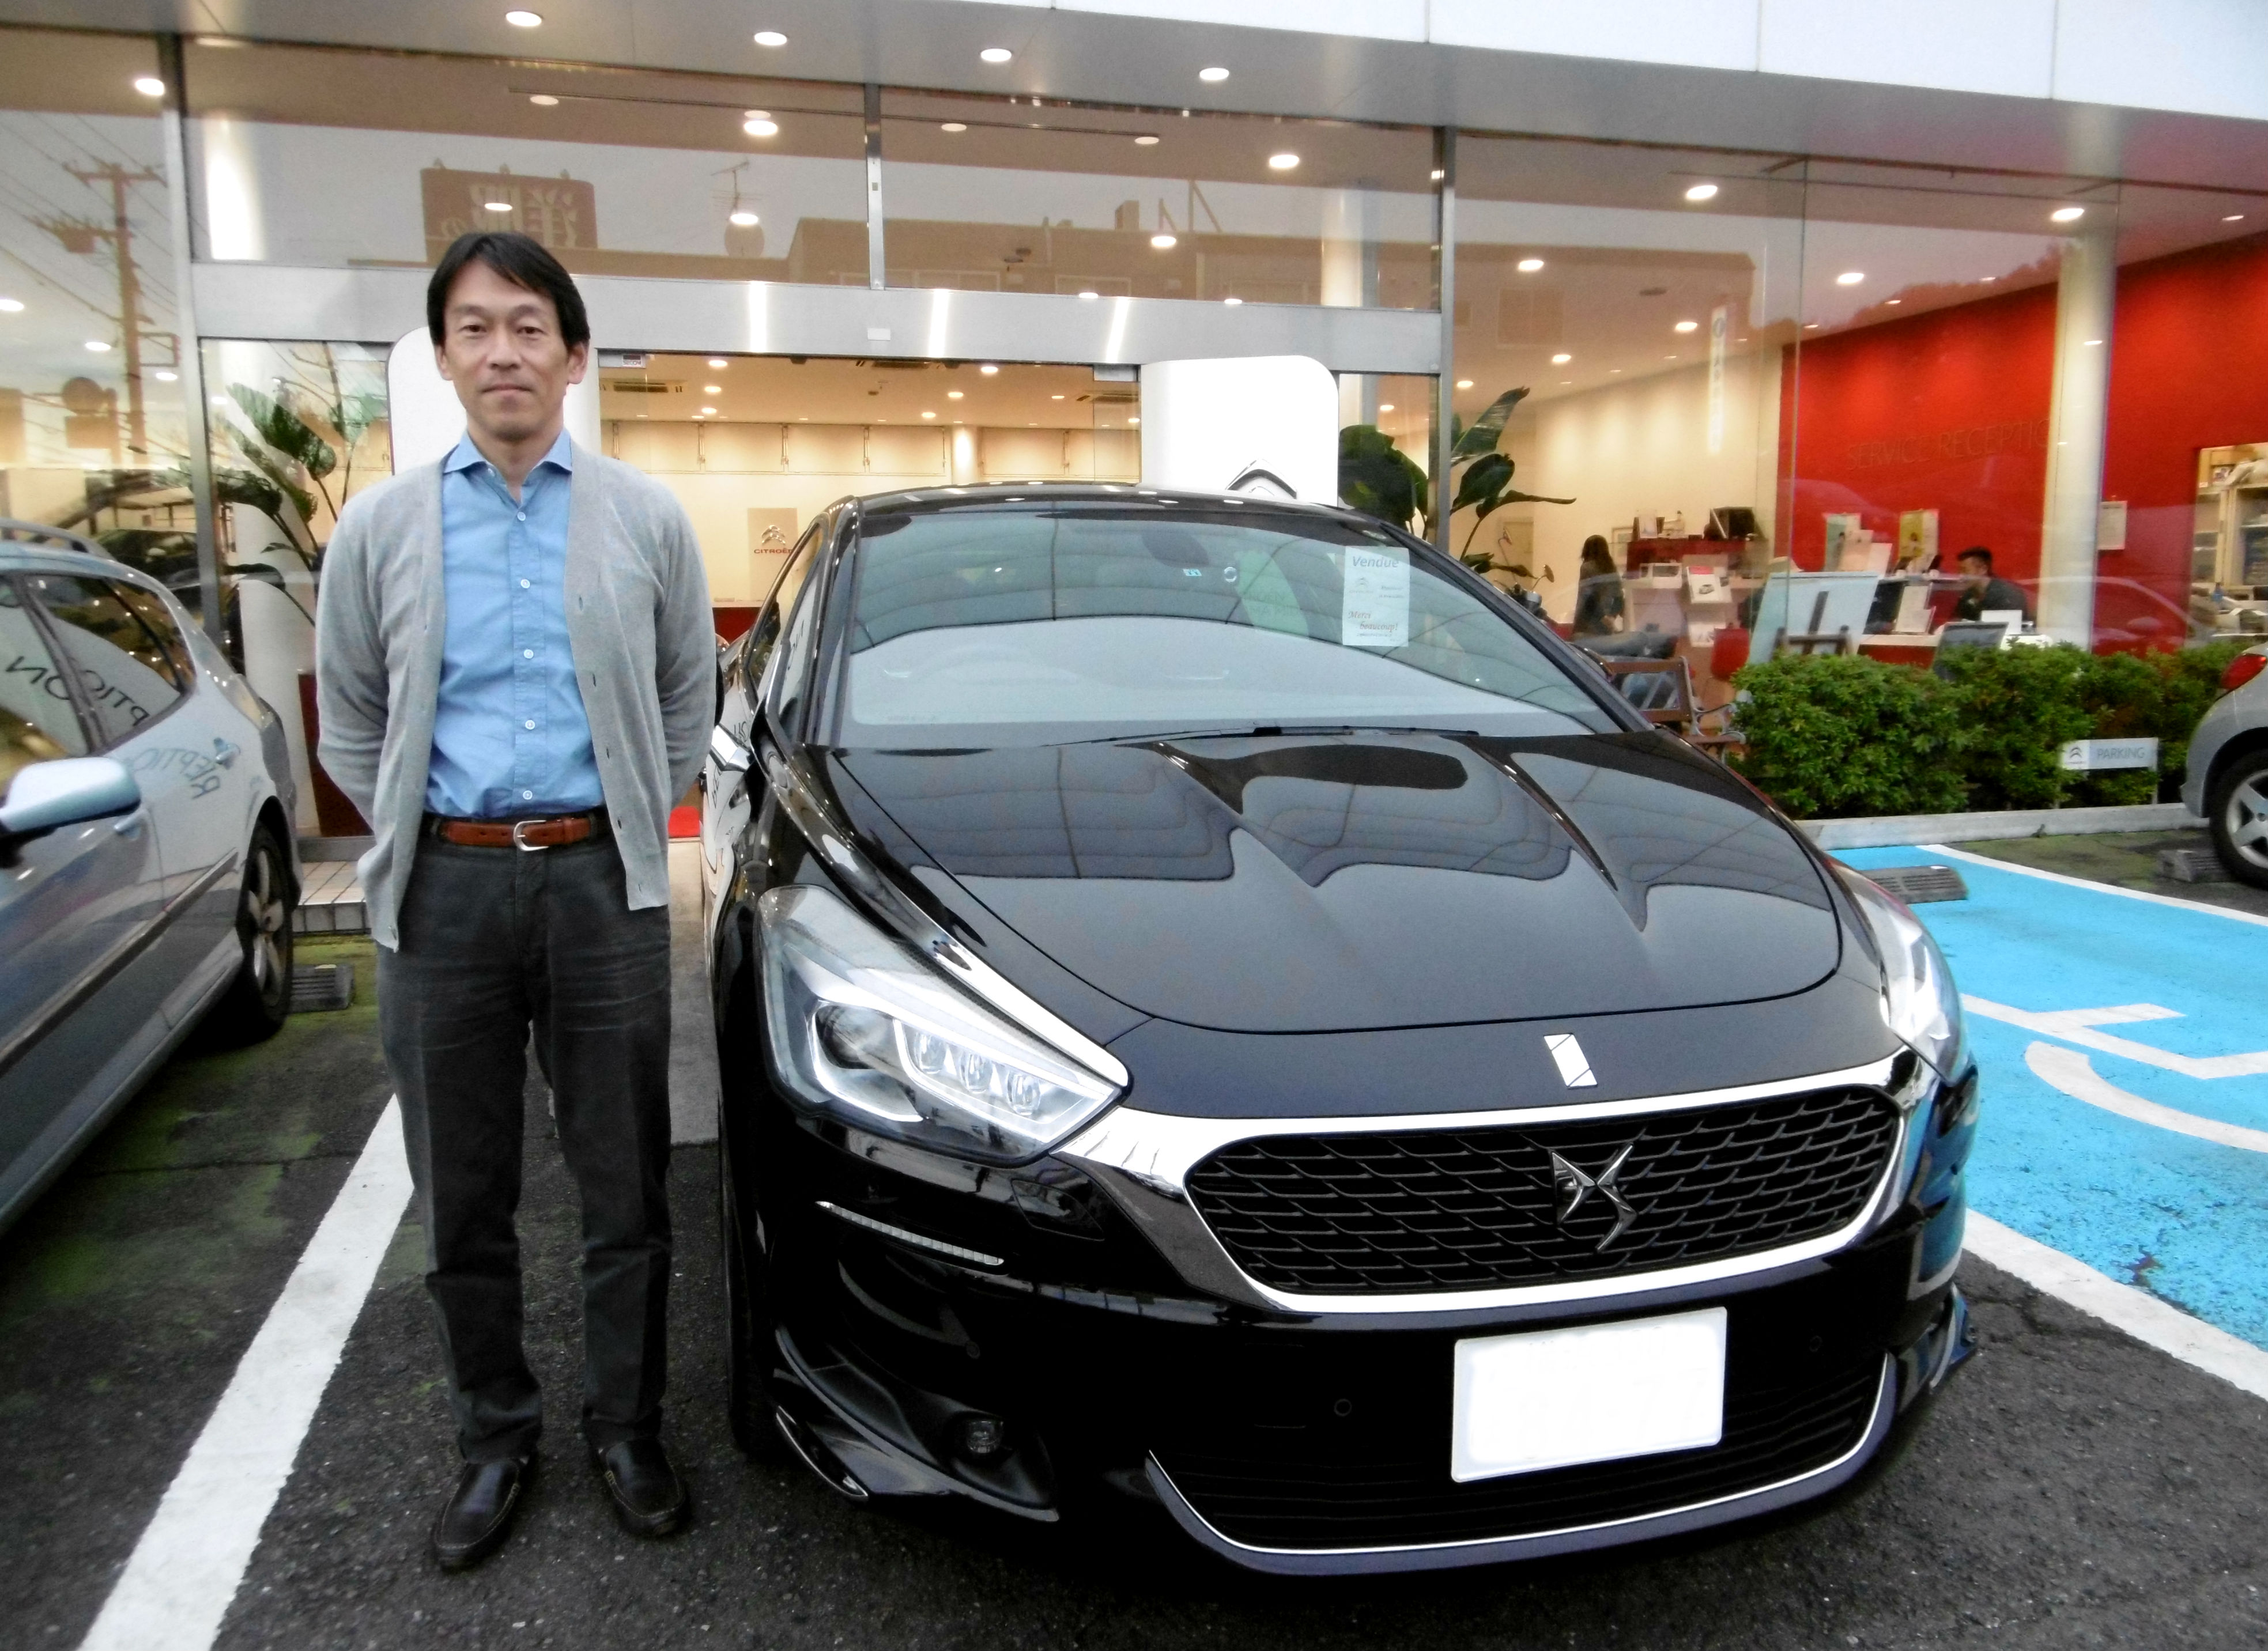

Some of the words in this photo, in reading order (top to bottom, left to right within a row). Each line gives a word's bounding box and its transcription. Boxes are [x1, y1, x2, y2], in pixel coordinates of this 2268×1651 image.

[1845, 435, 1931, 471] SERVICE
[1937, 419, 2048, 459] RECEPTIO
[1352, 556, 1399, 568] Vendue
[1348, 611, 1371, 619] Merci
[2097, 747, 2145, 760] PARKING
